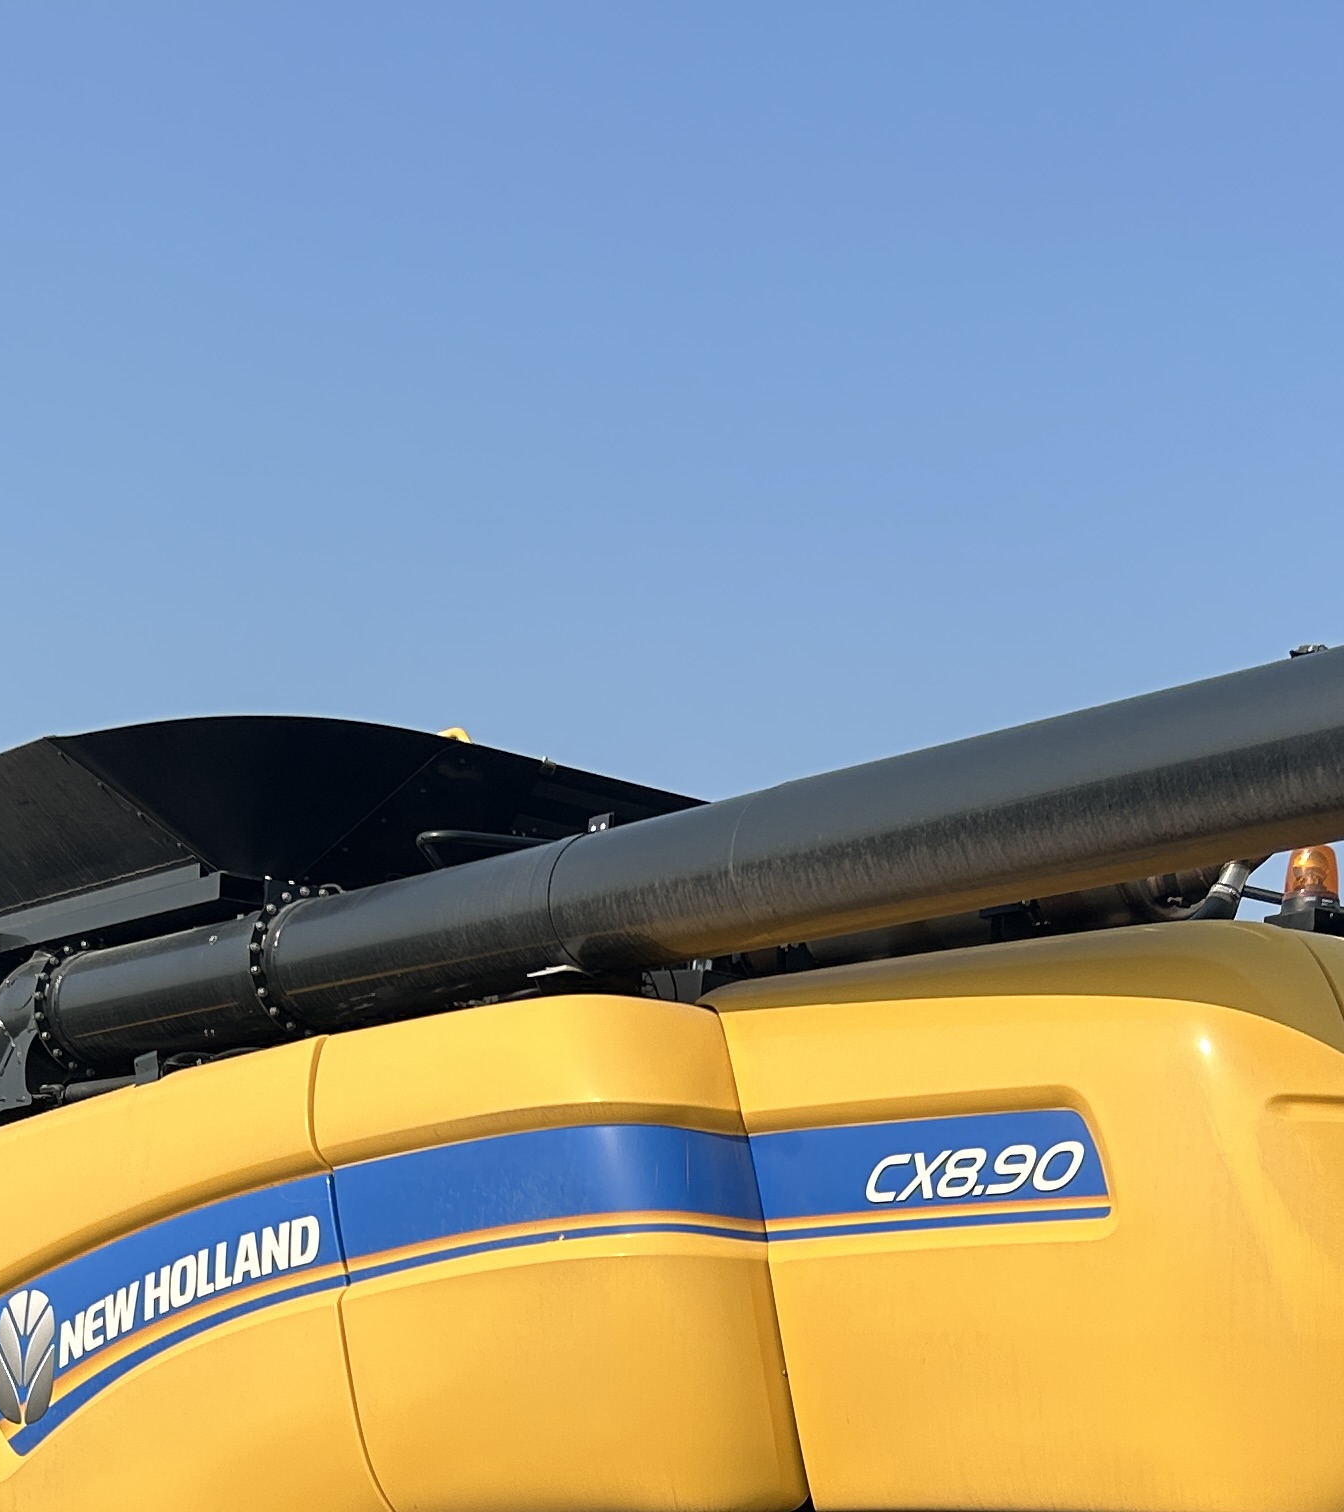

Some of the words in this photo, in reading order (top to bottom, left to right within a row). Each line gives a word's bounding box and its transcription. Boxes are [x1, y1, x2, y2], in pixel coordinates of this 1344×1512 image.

[865, 1141, 1085, 1203] CX8.90
[58, 1281, 140, 1369] NEW
[144, 1215, 320, 1321] HOLLAND
